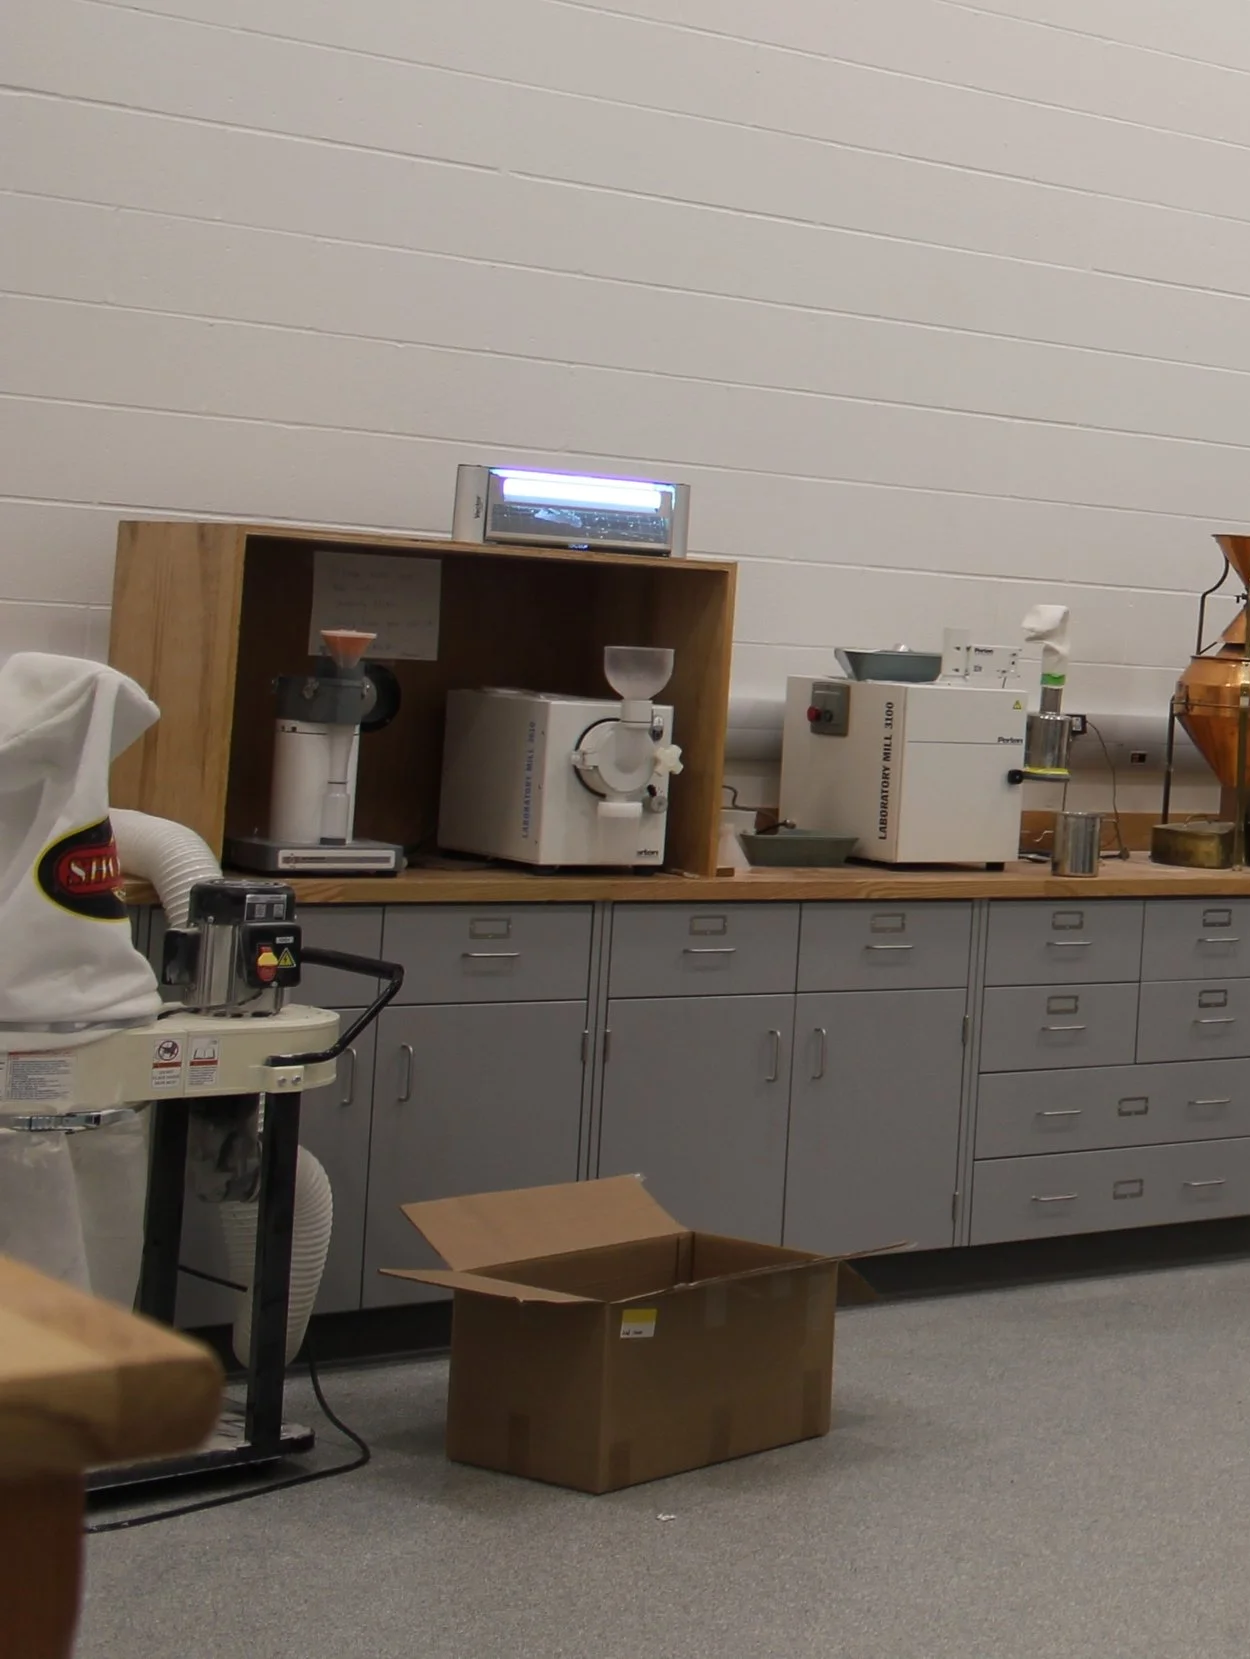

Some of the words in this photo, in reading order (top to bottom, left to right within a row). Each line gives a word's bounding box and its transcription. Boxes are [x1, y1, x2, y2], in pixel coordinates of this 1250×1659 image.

[884, 701, 895, 729] 3100
[882, 734, 893, 762] MILL
[521, 776, 532, 839] LABORATORY
[878, 765, 891, 840] LABORATORY
